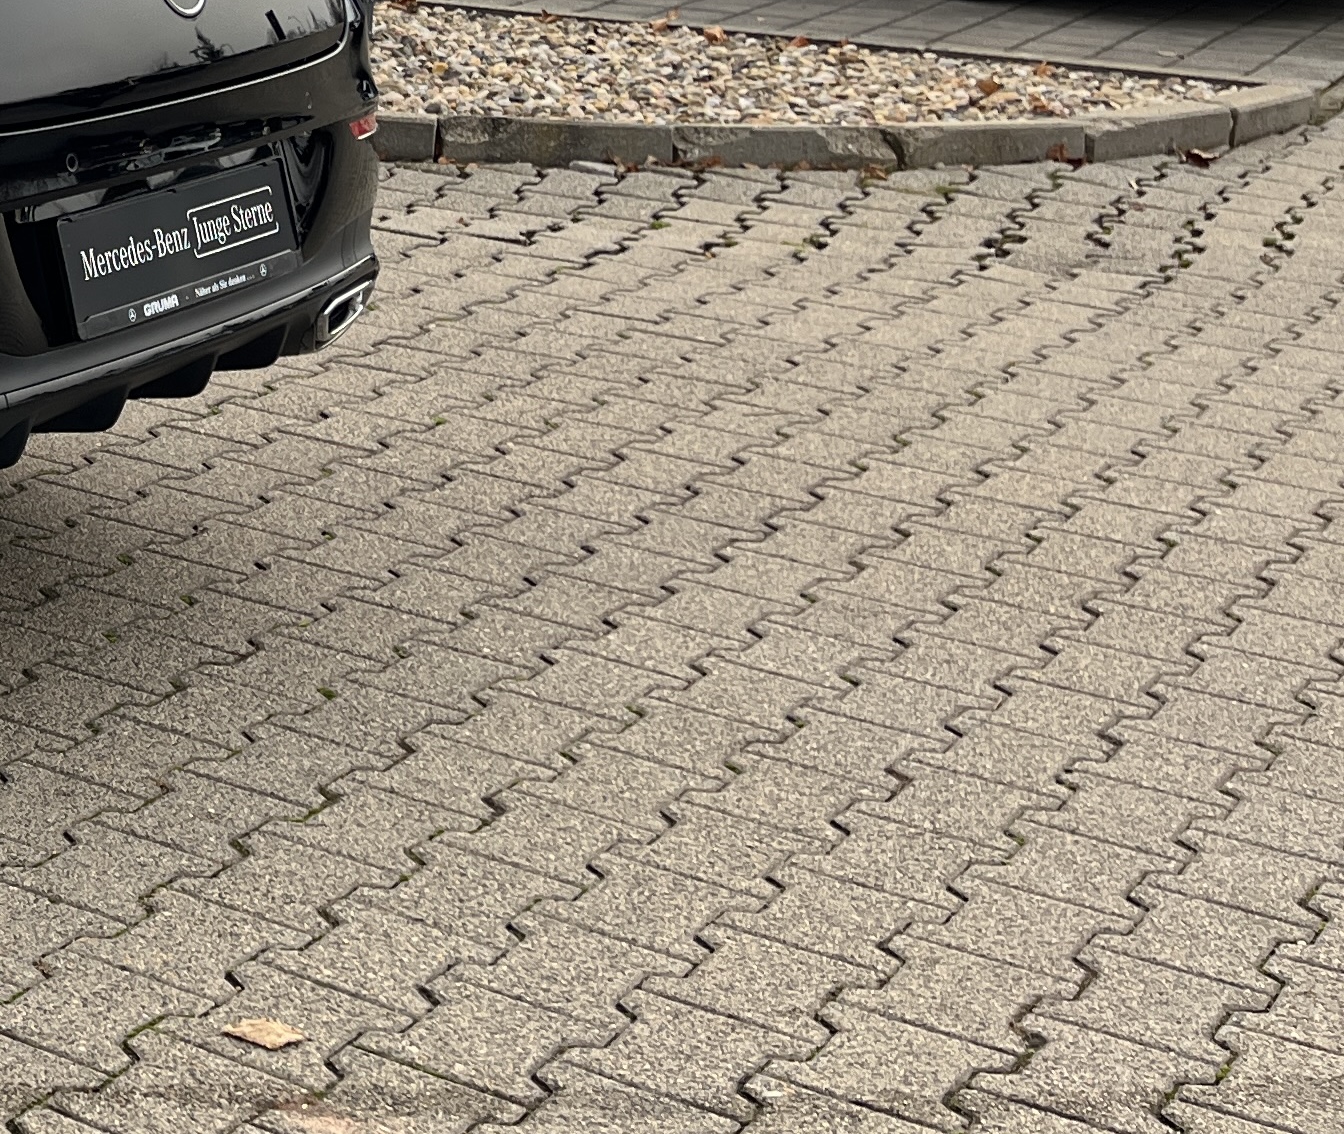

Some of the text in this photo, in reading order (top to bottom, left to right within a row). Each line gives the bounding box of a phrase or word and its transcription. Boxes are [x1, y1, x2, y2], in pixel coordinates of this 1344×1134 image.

[80, 201, 274, 281] Mercedes-Benz Junge Sterne
[143, 294, 179, 316] GRUMA
